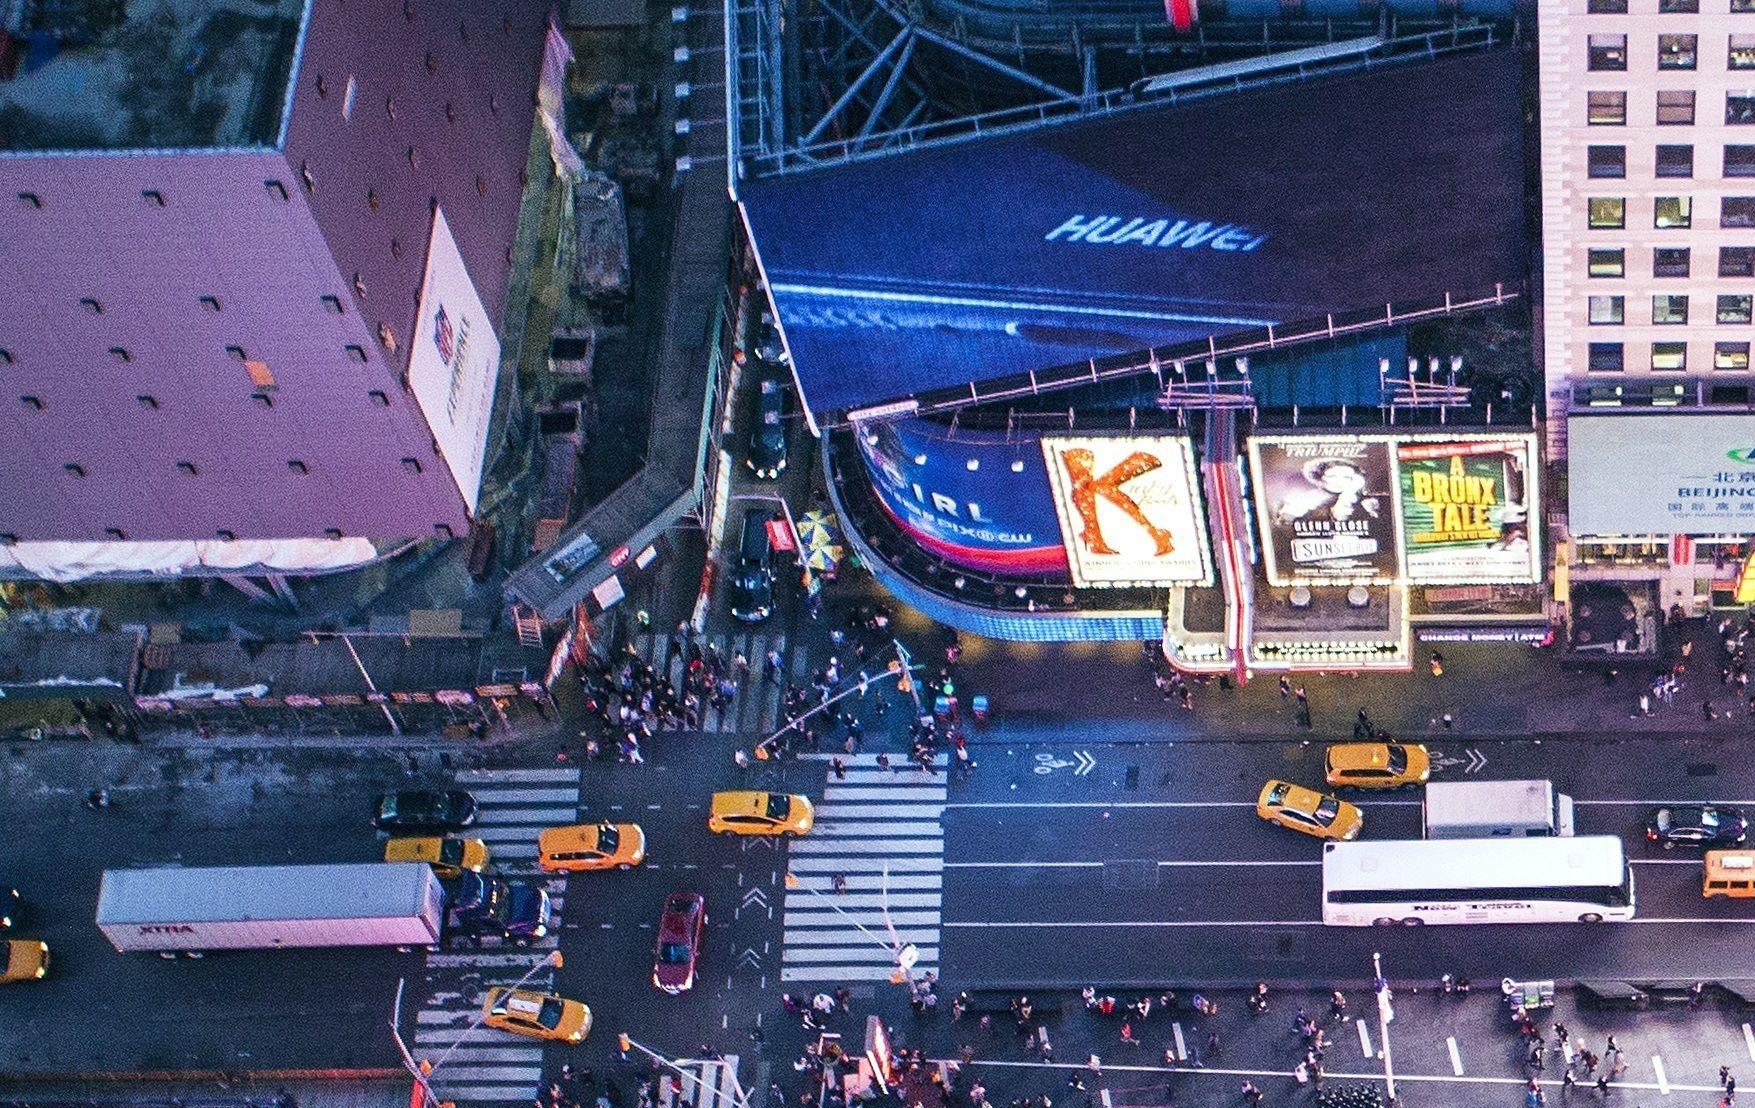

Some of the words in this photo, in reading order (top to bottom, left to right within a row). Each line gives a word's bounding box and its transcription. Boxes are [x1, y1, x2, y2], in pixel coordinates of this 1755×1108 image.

[1045, 214, 1267, 251] HUAWEI
[1450, 455, 1465, 477] A
[1412, 470, 1496, 506] BRONX
[1431, 502, 1492, 533] TALE
